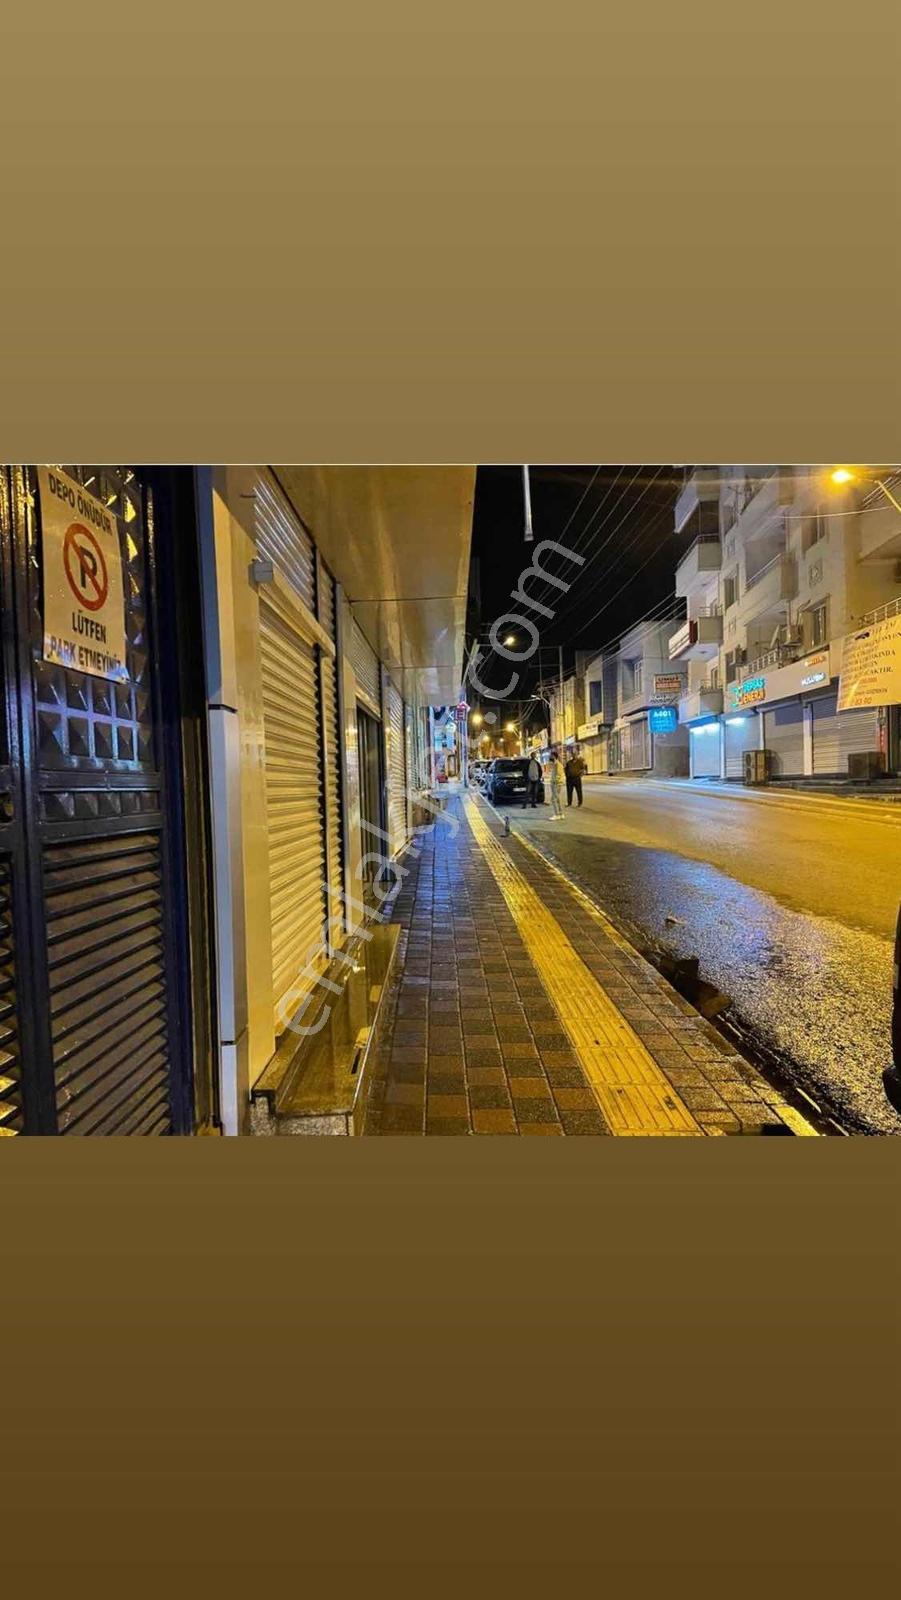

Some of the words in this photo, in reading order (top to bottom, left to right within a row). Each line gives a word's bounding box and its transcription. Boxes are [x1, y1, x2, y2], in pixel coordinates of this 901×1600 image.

[48, 472, 75, 509] DEPO
[72, 609, 107, 644] LÜTFEN
[50, 635, 76, 664] PARK
